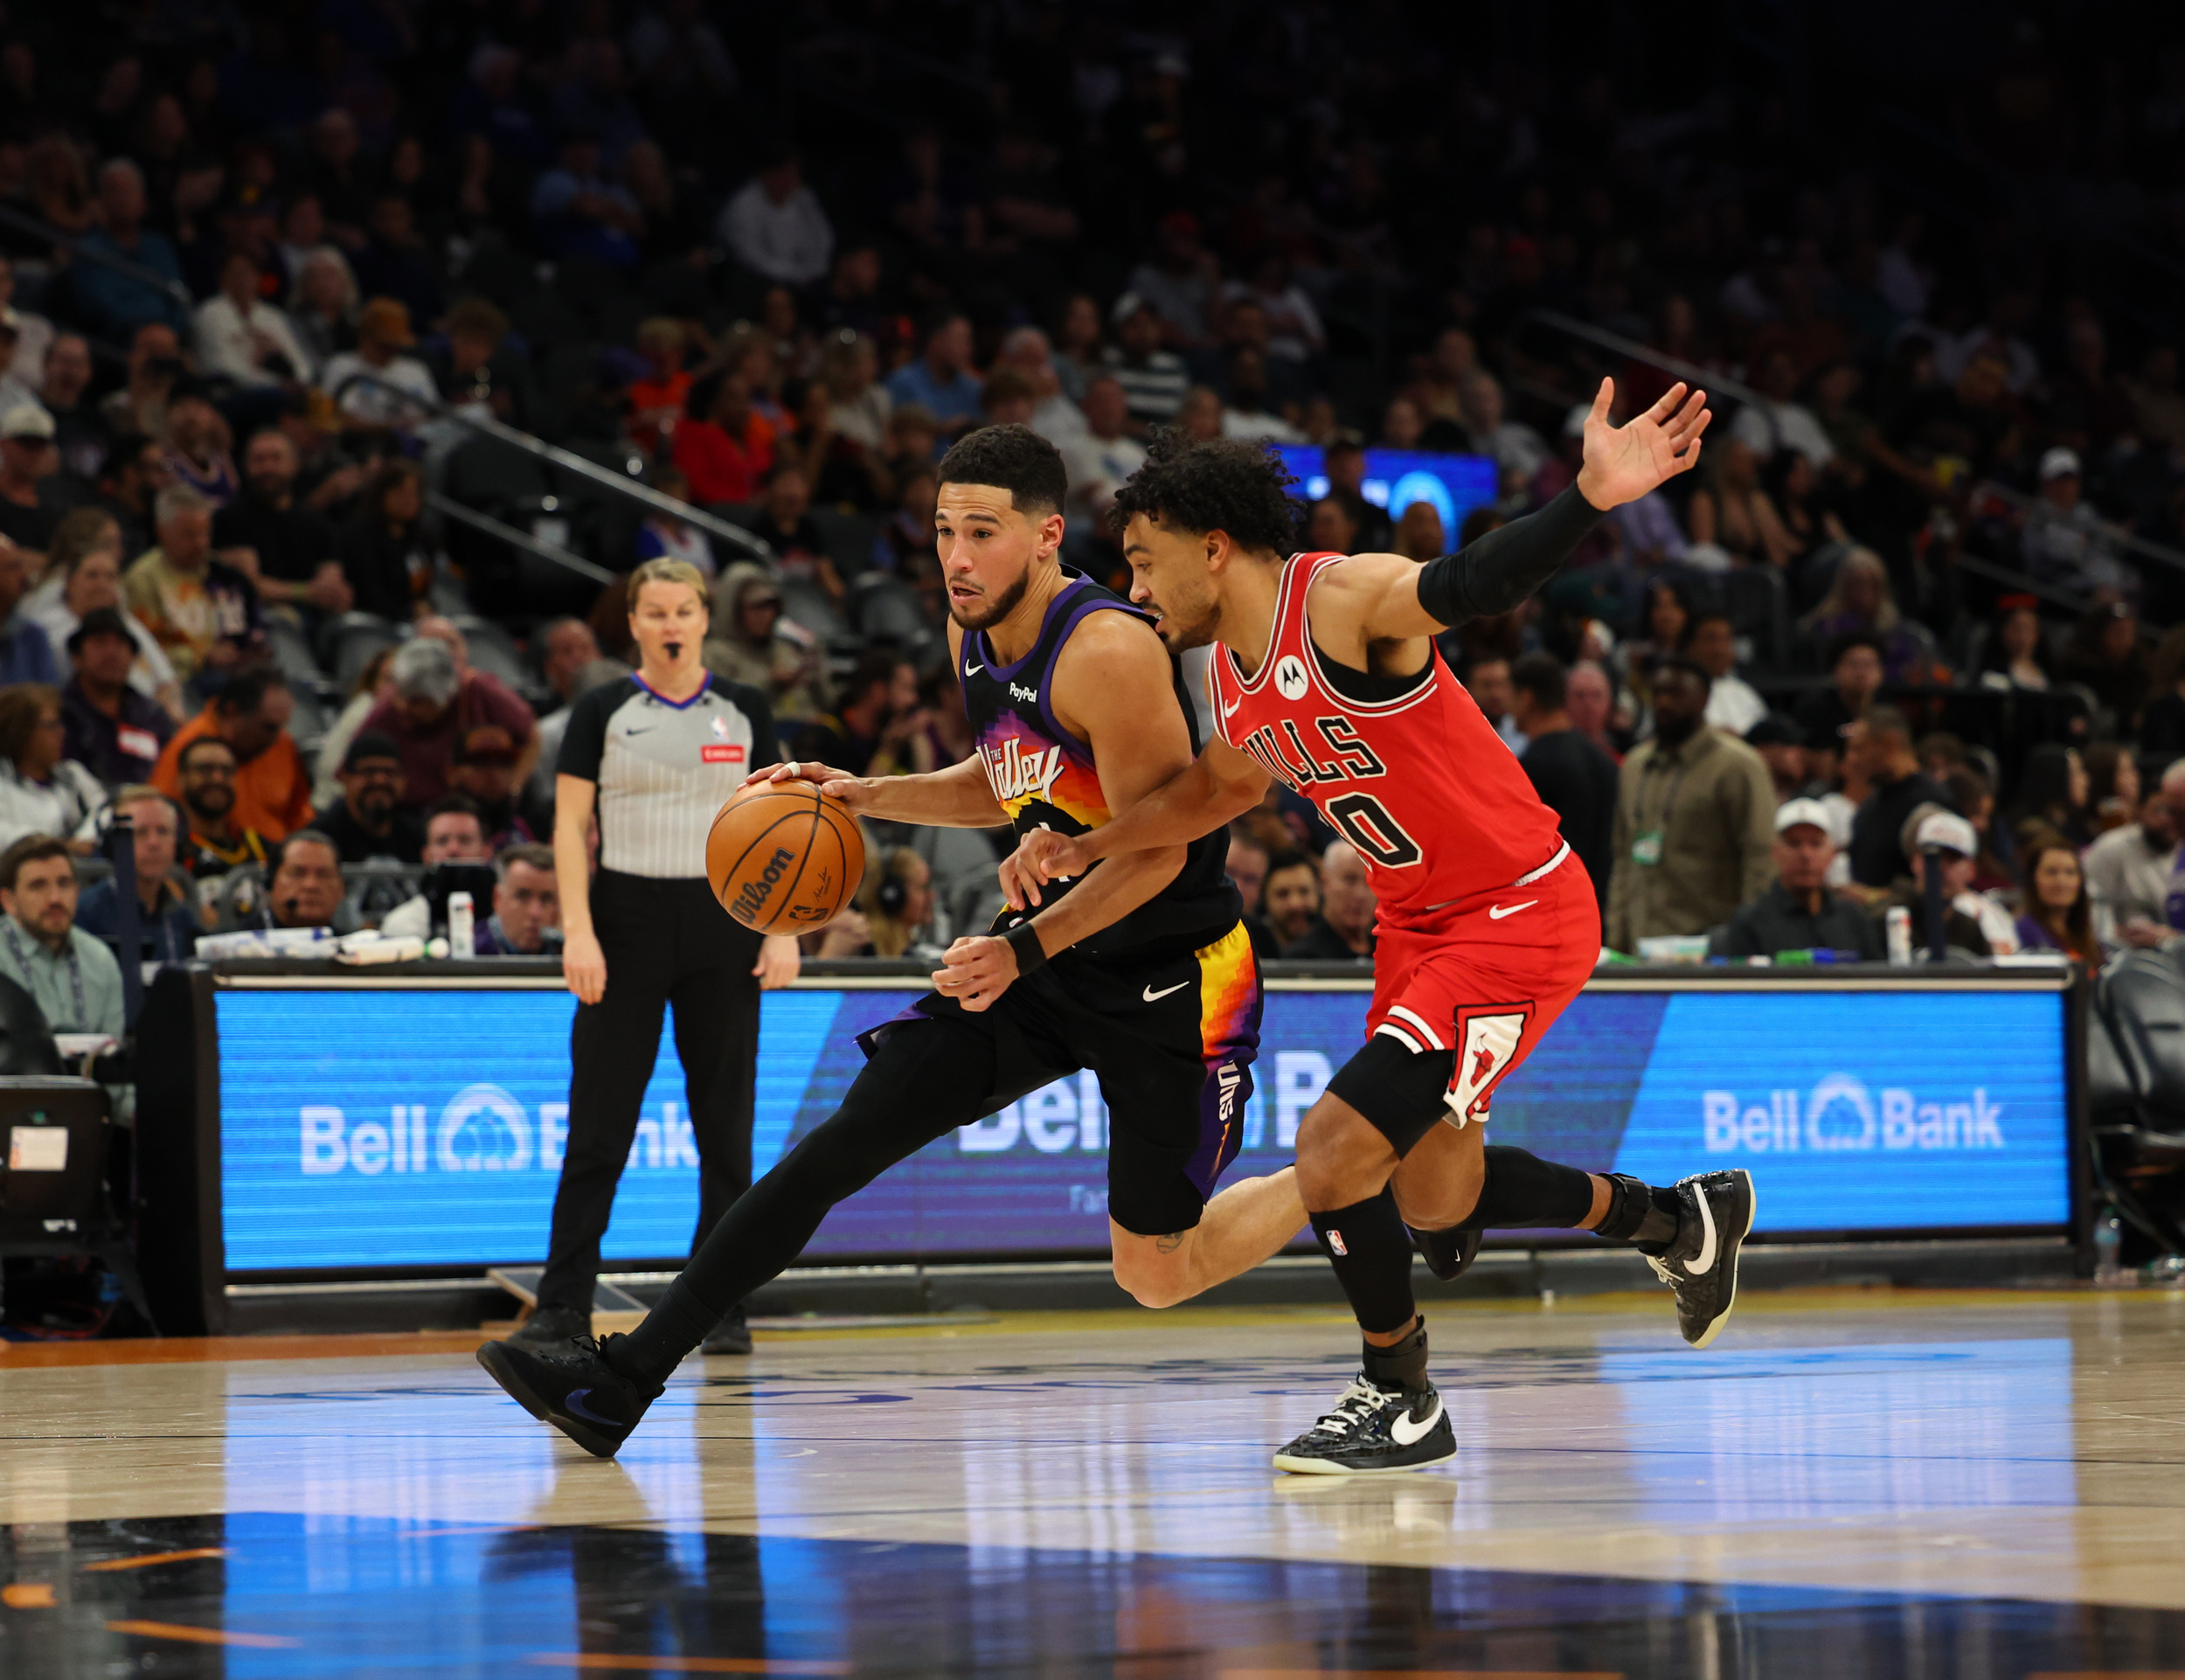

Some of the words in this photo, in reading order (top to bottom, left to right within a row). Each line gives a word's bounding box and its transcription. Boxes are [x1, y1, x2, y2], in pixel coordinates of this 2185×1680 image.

[1009, 682, 1037, 703] PayPal
[975, 738, 1065, 804] Valley
[990, 748, 1002, 761] THE
[1239, 715, 1387, 793] ULLS
[1317, 791, 1423, 872] 0
[731, 847, 795, 925] Wilson
[1217, 1059, 1241, 1121] UNS
[1702, 1089, 1799, 1153] Bell
[1881, 1087, 2004, 1149] Bank
[300, 1105, 427, 1175] Bell
[538, 1101, 700, 1170] Bnk
